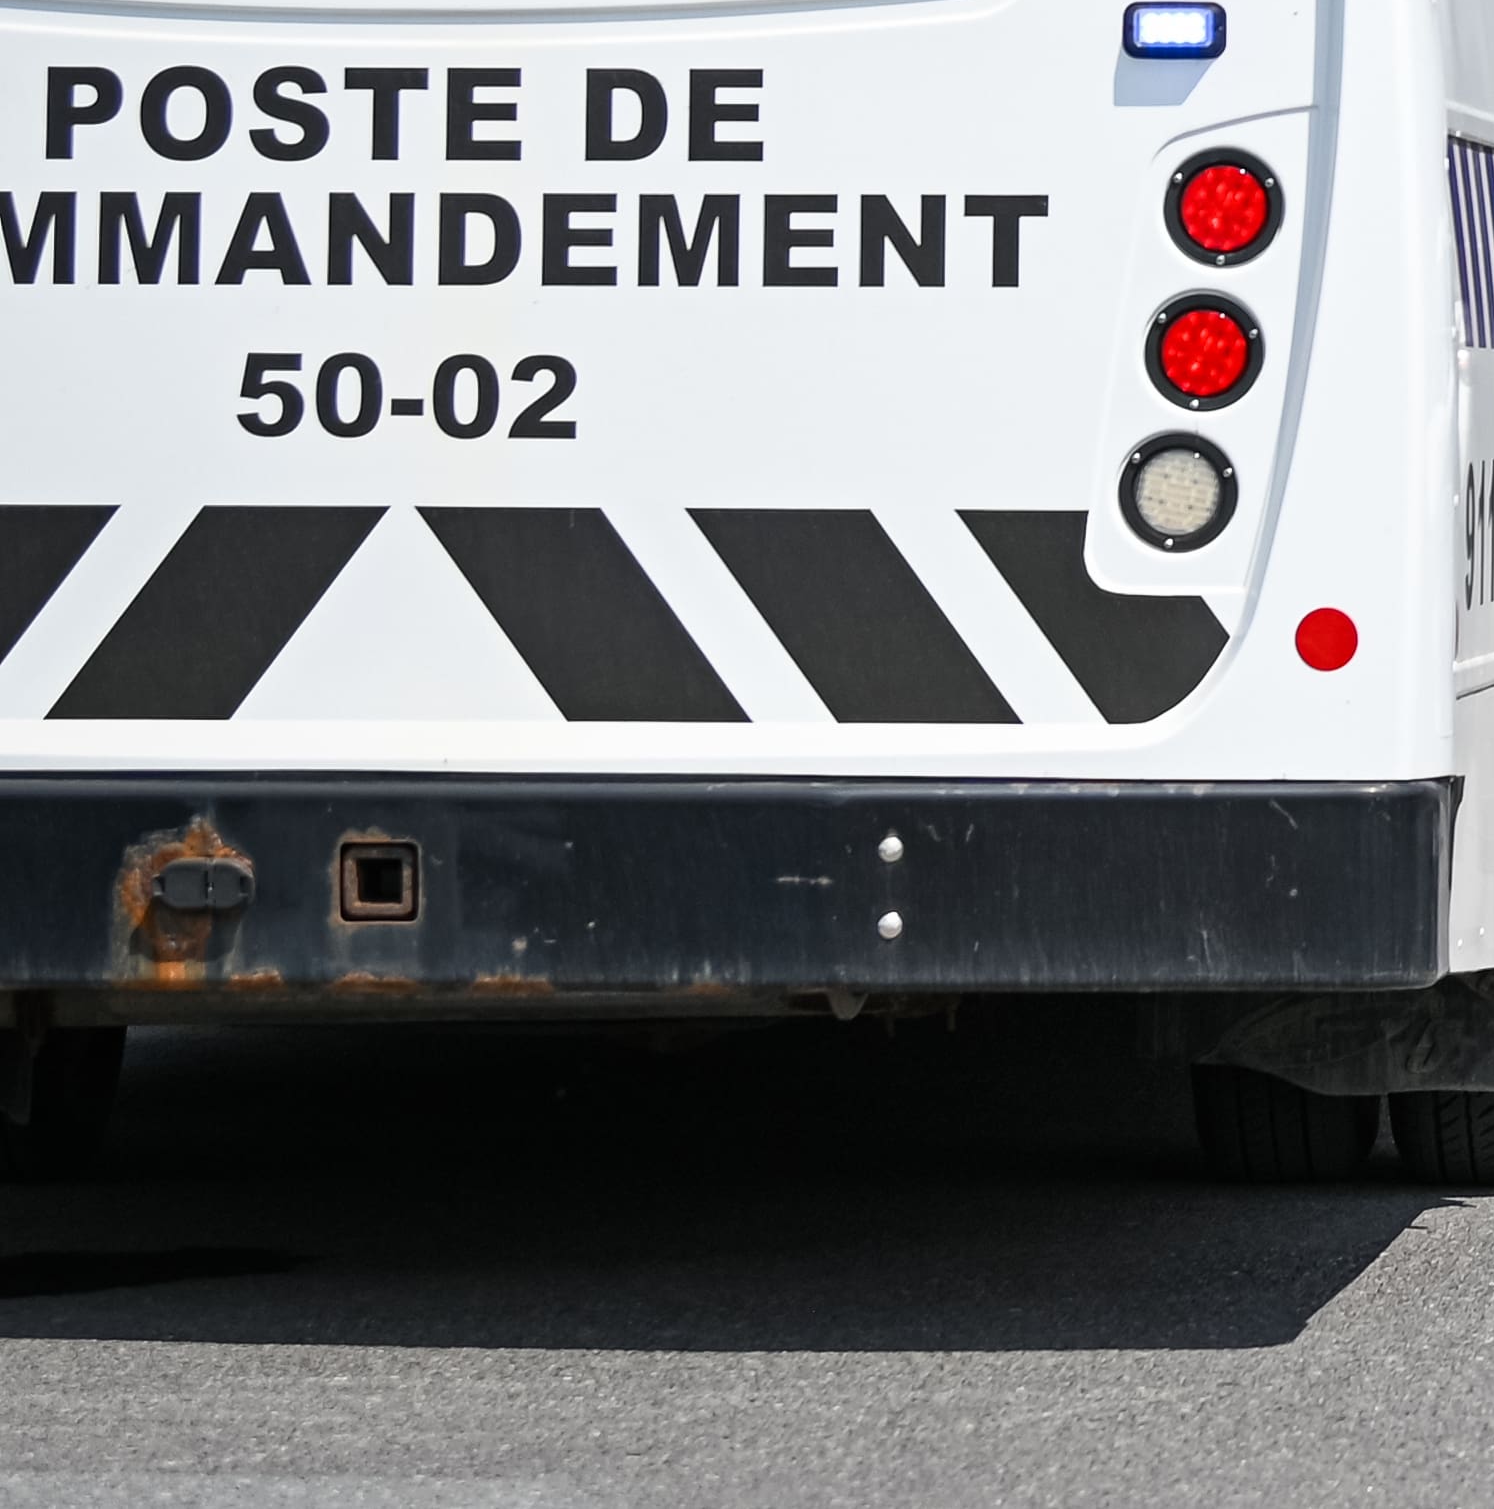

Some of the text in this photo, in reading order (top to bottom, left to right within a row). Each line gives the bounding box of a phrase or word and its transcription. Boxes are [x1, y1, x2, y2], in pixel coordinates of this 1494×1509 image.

[45, 65, 764, 162] POSTE DE
[236, 352, 577, 440] 50-02
